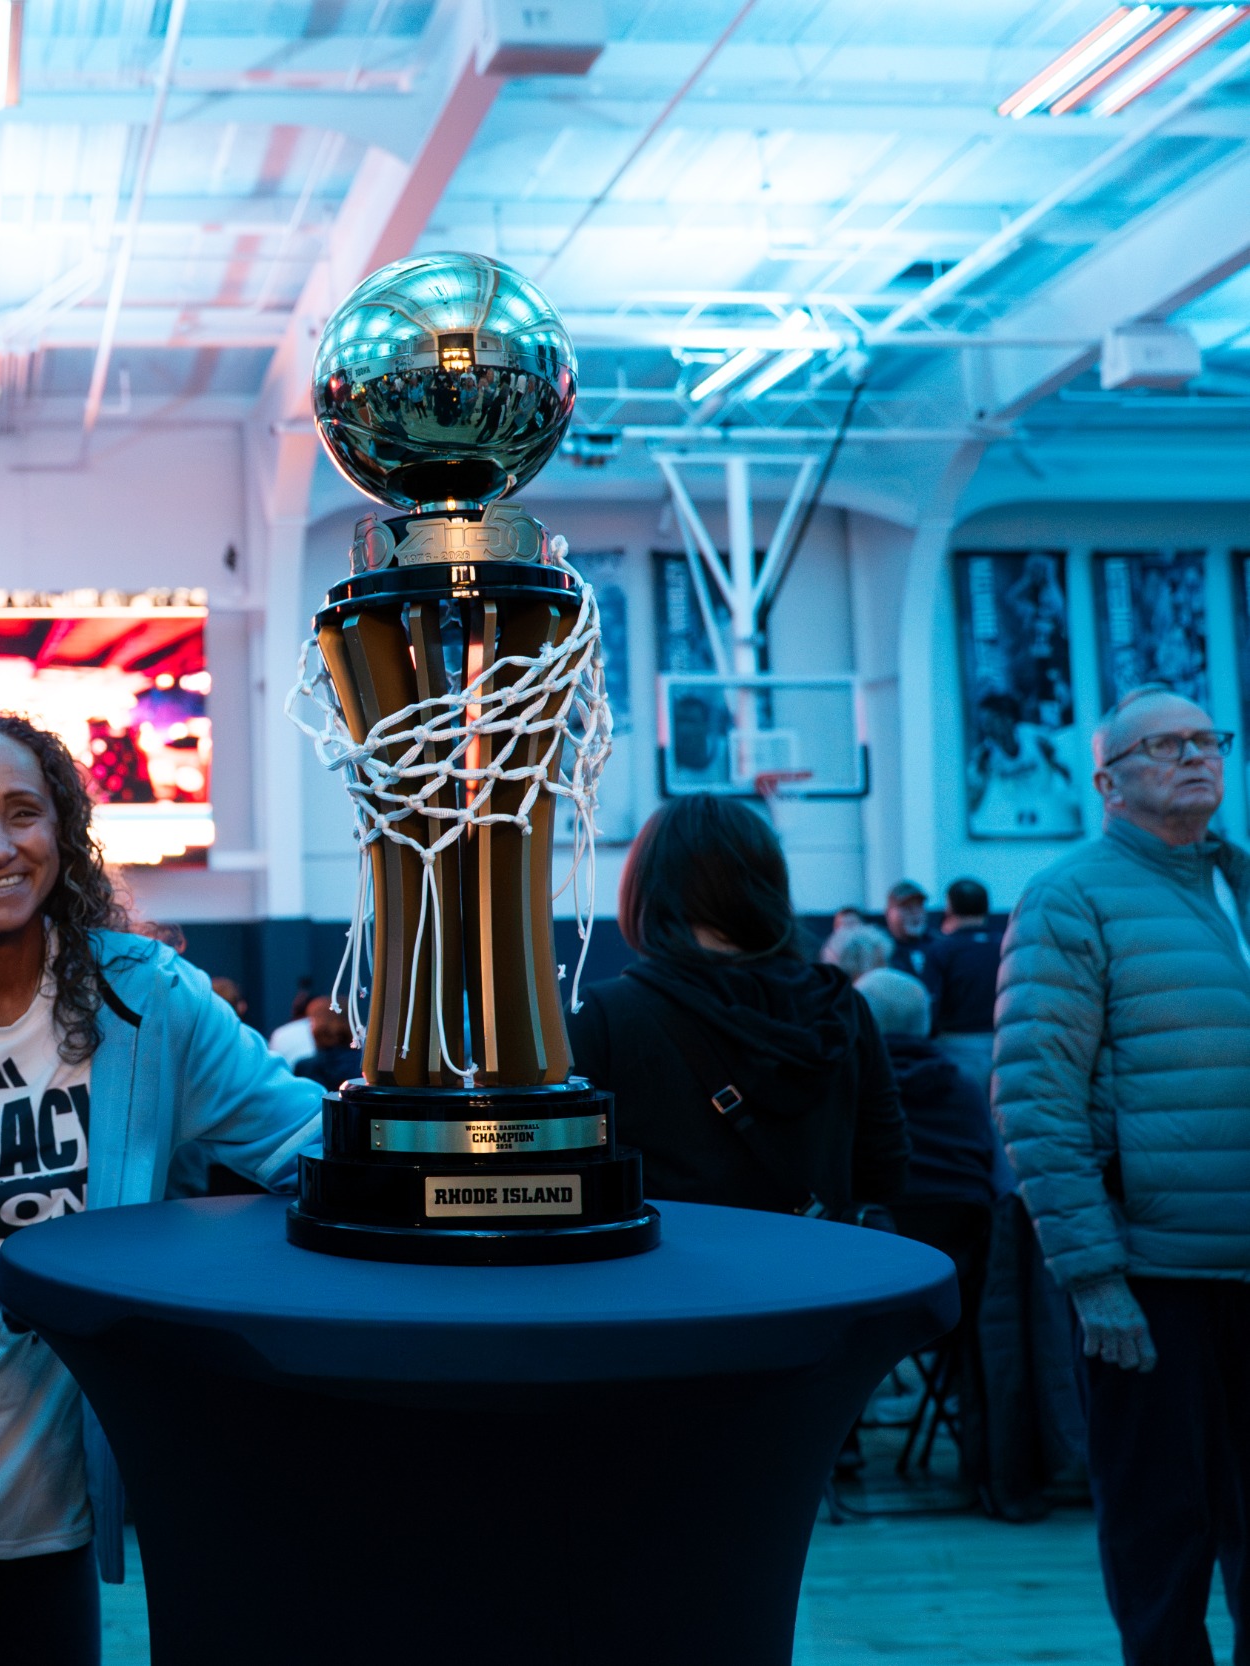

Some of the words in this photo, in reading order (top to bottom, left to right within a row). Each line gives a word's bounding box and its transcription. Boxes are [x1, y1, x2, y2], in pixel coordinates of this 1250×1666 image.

[498, 1123, 540, 1131] BASKETBALL
[472, 1132, 535, 1144] CHAMPION
[434, 1187, 498, 1206] RHODE
[502, 1186, 573, 1205] ISLAND
